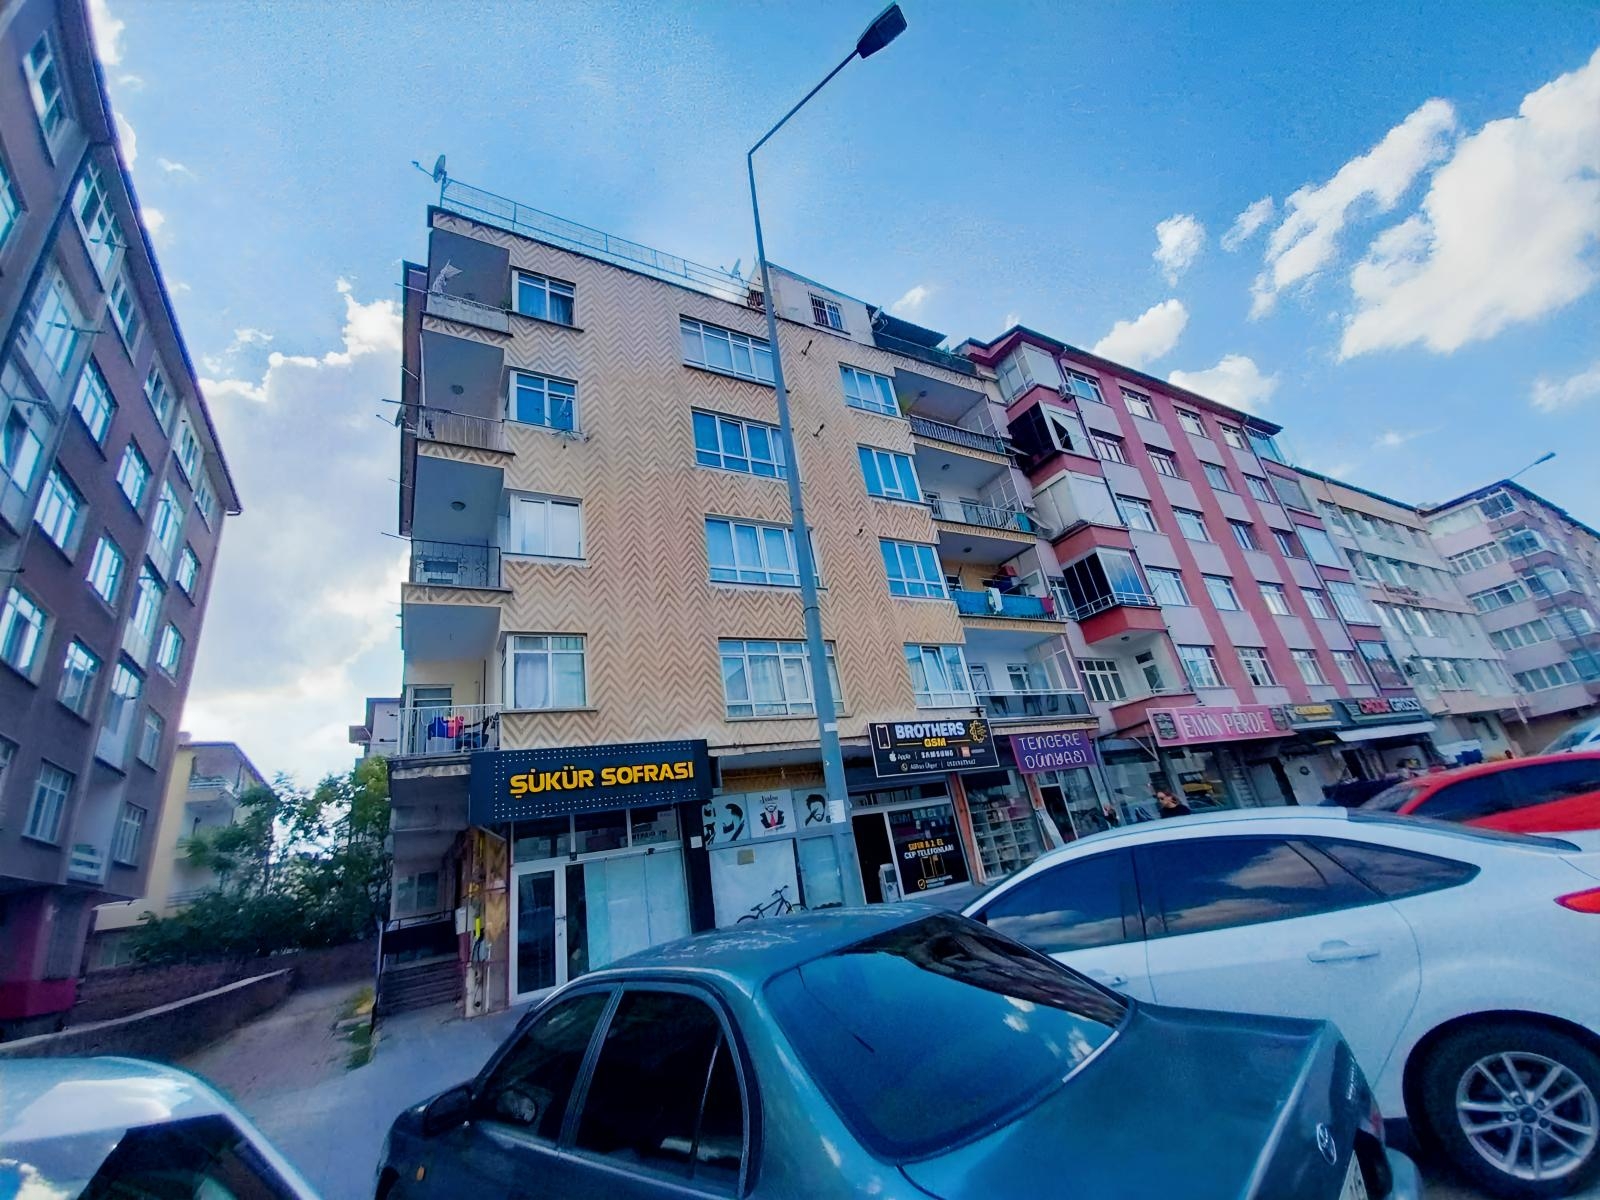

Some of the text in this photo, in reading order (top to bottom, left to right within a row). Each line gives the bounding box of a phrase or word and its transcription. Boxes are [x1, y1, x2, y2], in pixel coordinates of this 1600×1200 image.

[895, 722, 965, 739] BROTHERS
[1222, 711, 1270, 735] PERDE
[924, 737, 947, 748] GSM
[1018, 732, 1082, 751] TENCERE
[921, 749, 954, 759] SAMSUNG
[1024, 749, 1087, 769] DÜNYASI
[600, 761, 695, 786] SOFRASI
